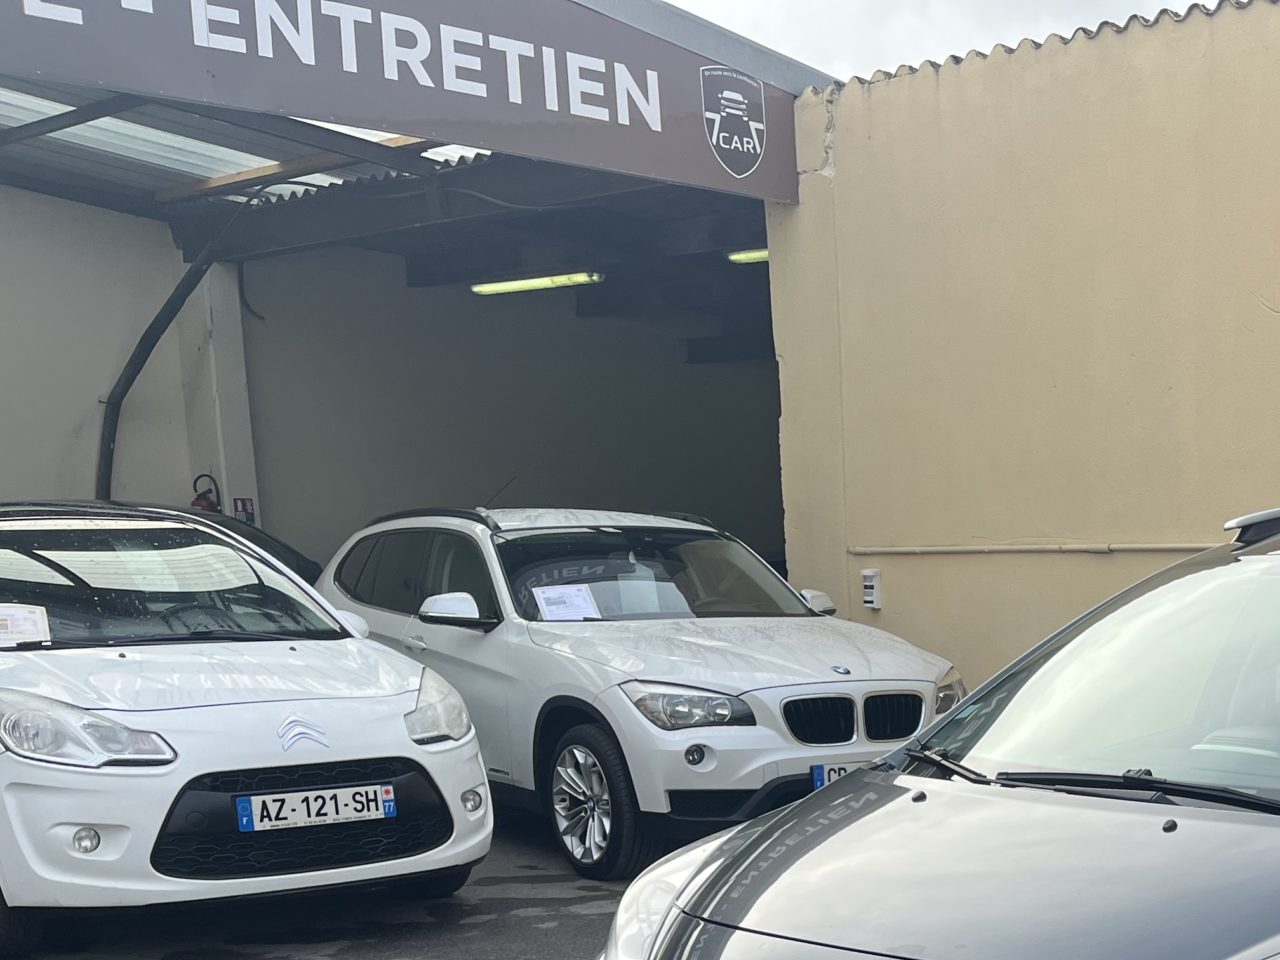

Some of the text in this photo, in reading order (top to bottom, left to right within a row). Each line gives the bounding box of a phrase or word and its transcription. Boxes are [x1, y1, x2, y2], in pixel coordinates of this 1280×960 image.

[190, 0, 662, 132] ENTRETIEN
[242, 817, 249, 826] F
[258, 789, 380, 823] AZ-121-SH
[383, 801, 394, 813] 77
